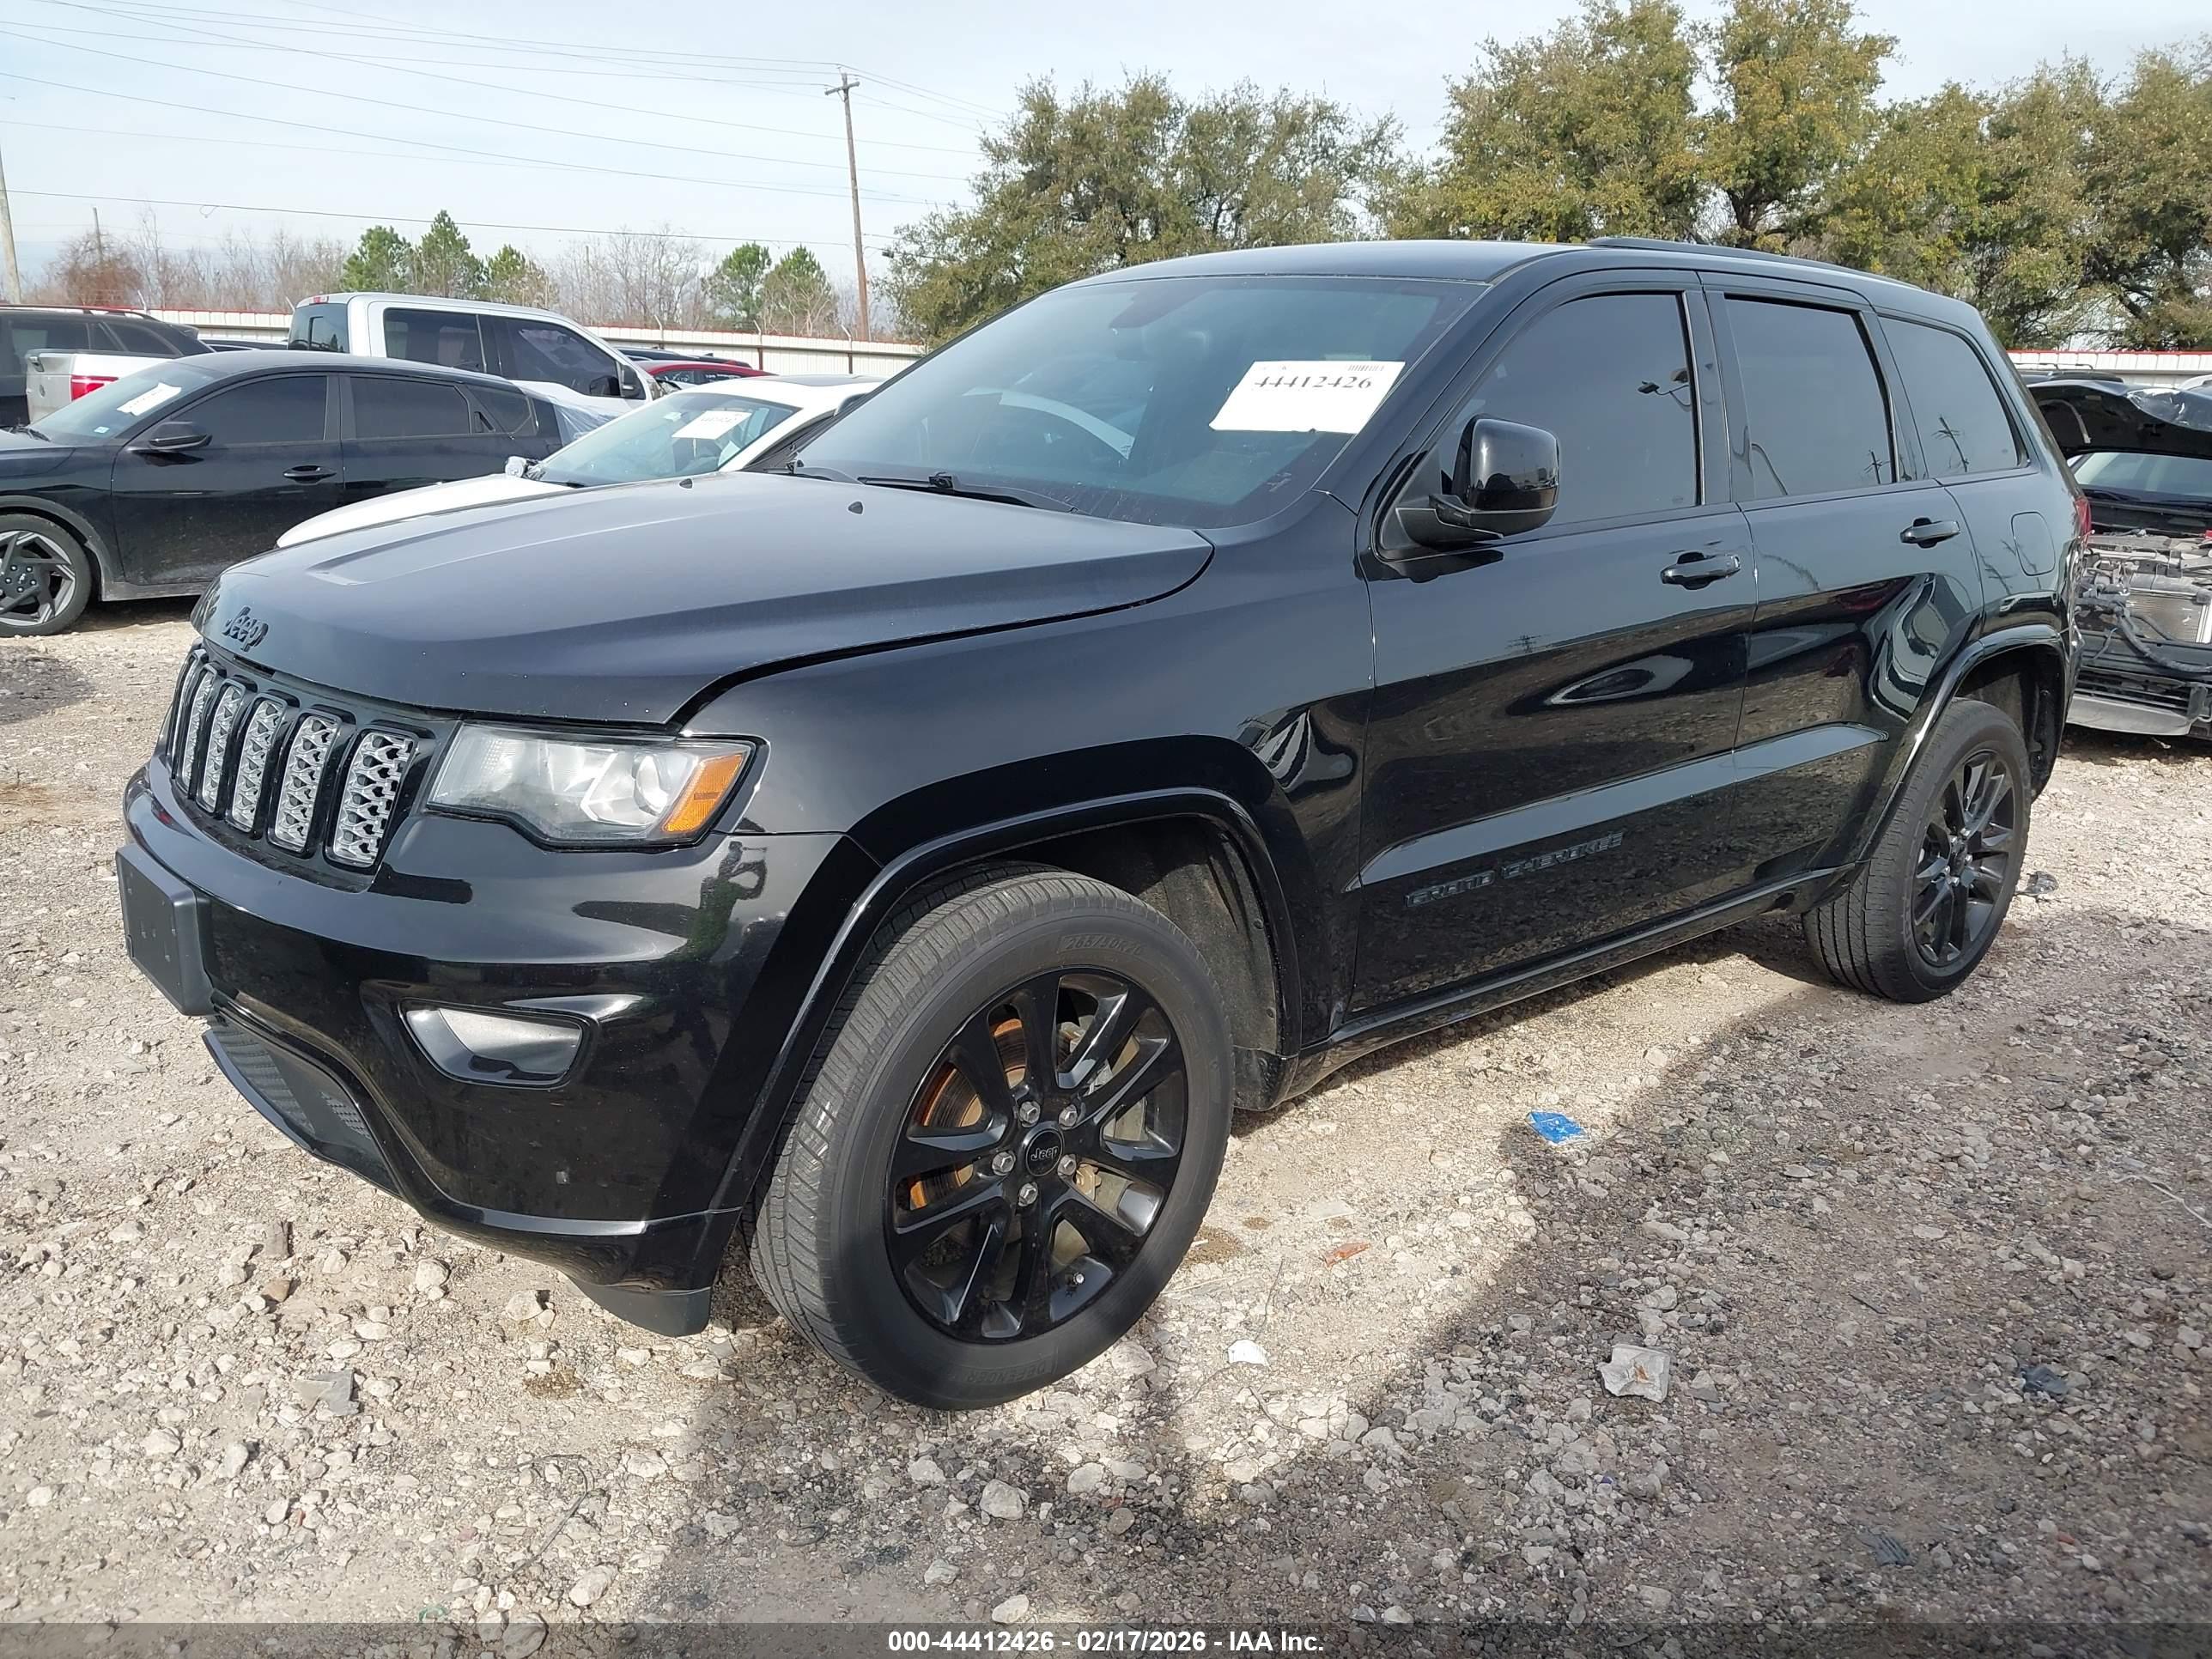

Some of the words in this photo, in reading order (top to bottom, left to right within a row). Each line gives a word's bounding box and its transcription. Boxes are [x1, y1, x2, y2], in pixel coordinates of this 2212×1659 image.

[1255, 376, 1372, 388] 44412426
[222, 605, 269, 653] Jeep
[1405, 870, 1497, 907] GRAND
[1502, 831, 1624, 879] CHEROKEE
[1030, 1146, 1059, 1161] Jeep
